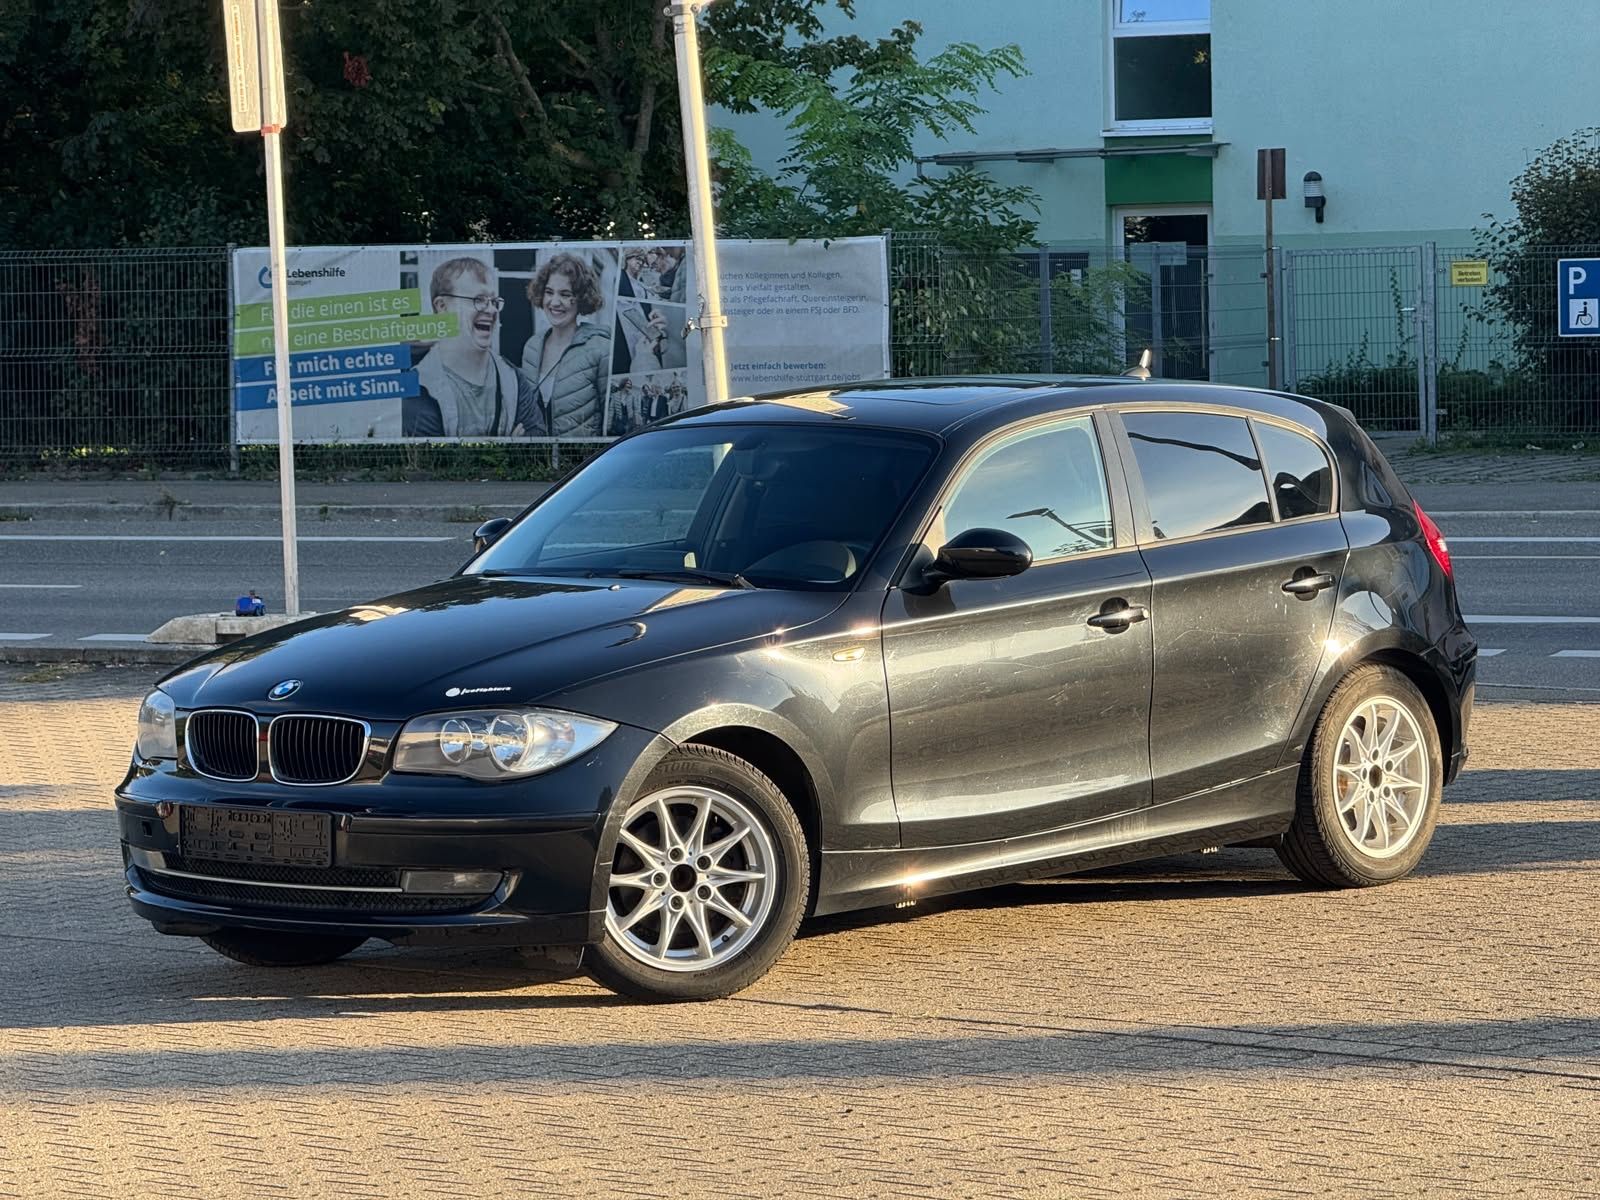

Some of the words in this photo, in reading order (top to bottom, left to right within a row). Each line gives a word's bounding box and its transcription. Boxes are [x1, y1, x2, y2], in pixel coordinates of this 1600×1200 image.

[286, 267, 346, 279] Lebenshilfe
[745, 271, 790, 281] Kolleginnen
[791, 271, 806, 280] und
[1568, 266, 1587, 295] P
[745, 283, 772, 292] Vielfalt
[291, 302, 315, 320] die
[319, 299, 364, 316] einen
[367, 297, 389, 311] ist
[391, 295, 410, 310] es
[756, 306, 774, 315] oder
[776, 306, 785, 315] in
[786, 306, 809, 315] einem
[810, 305, 822, 316] FSJ
[823, 305, 841, 314] oder
[294, 328, 328, 346] eine
[332, 320, 451, 344] Beschäftigung.
[296, 351, 340, 373] mich
[344, 352, 395, 370] echte
[730, 361, 750, 371] Jetzt
[751, 361, 782, 370] einfach
[783, 361, 827, 370] bewerben:
[325, 382, 357, 398] mit
[360, 379, 405, 396] Sinn.
